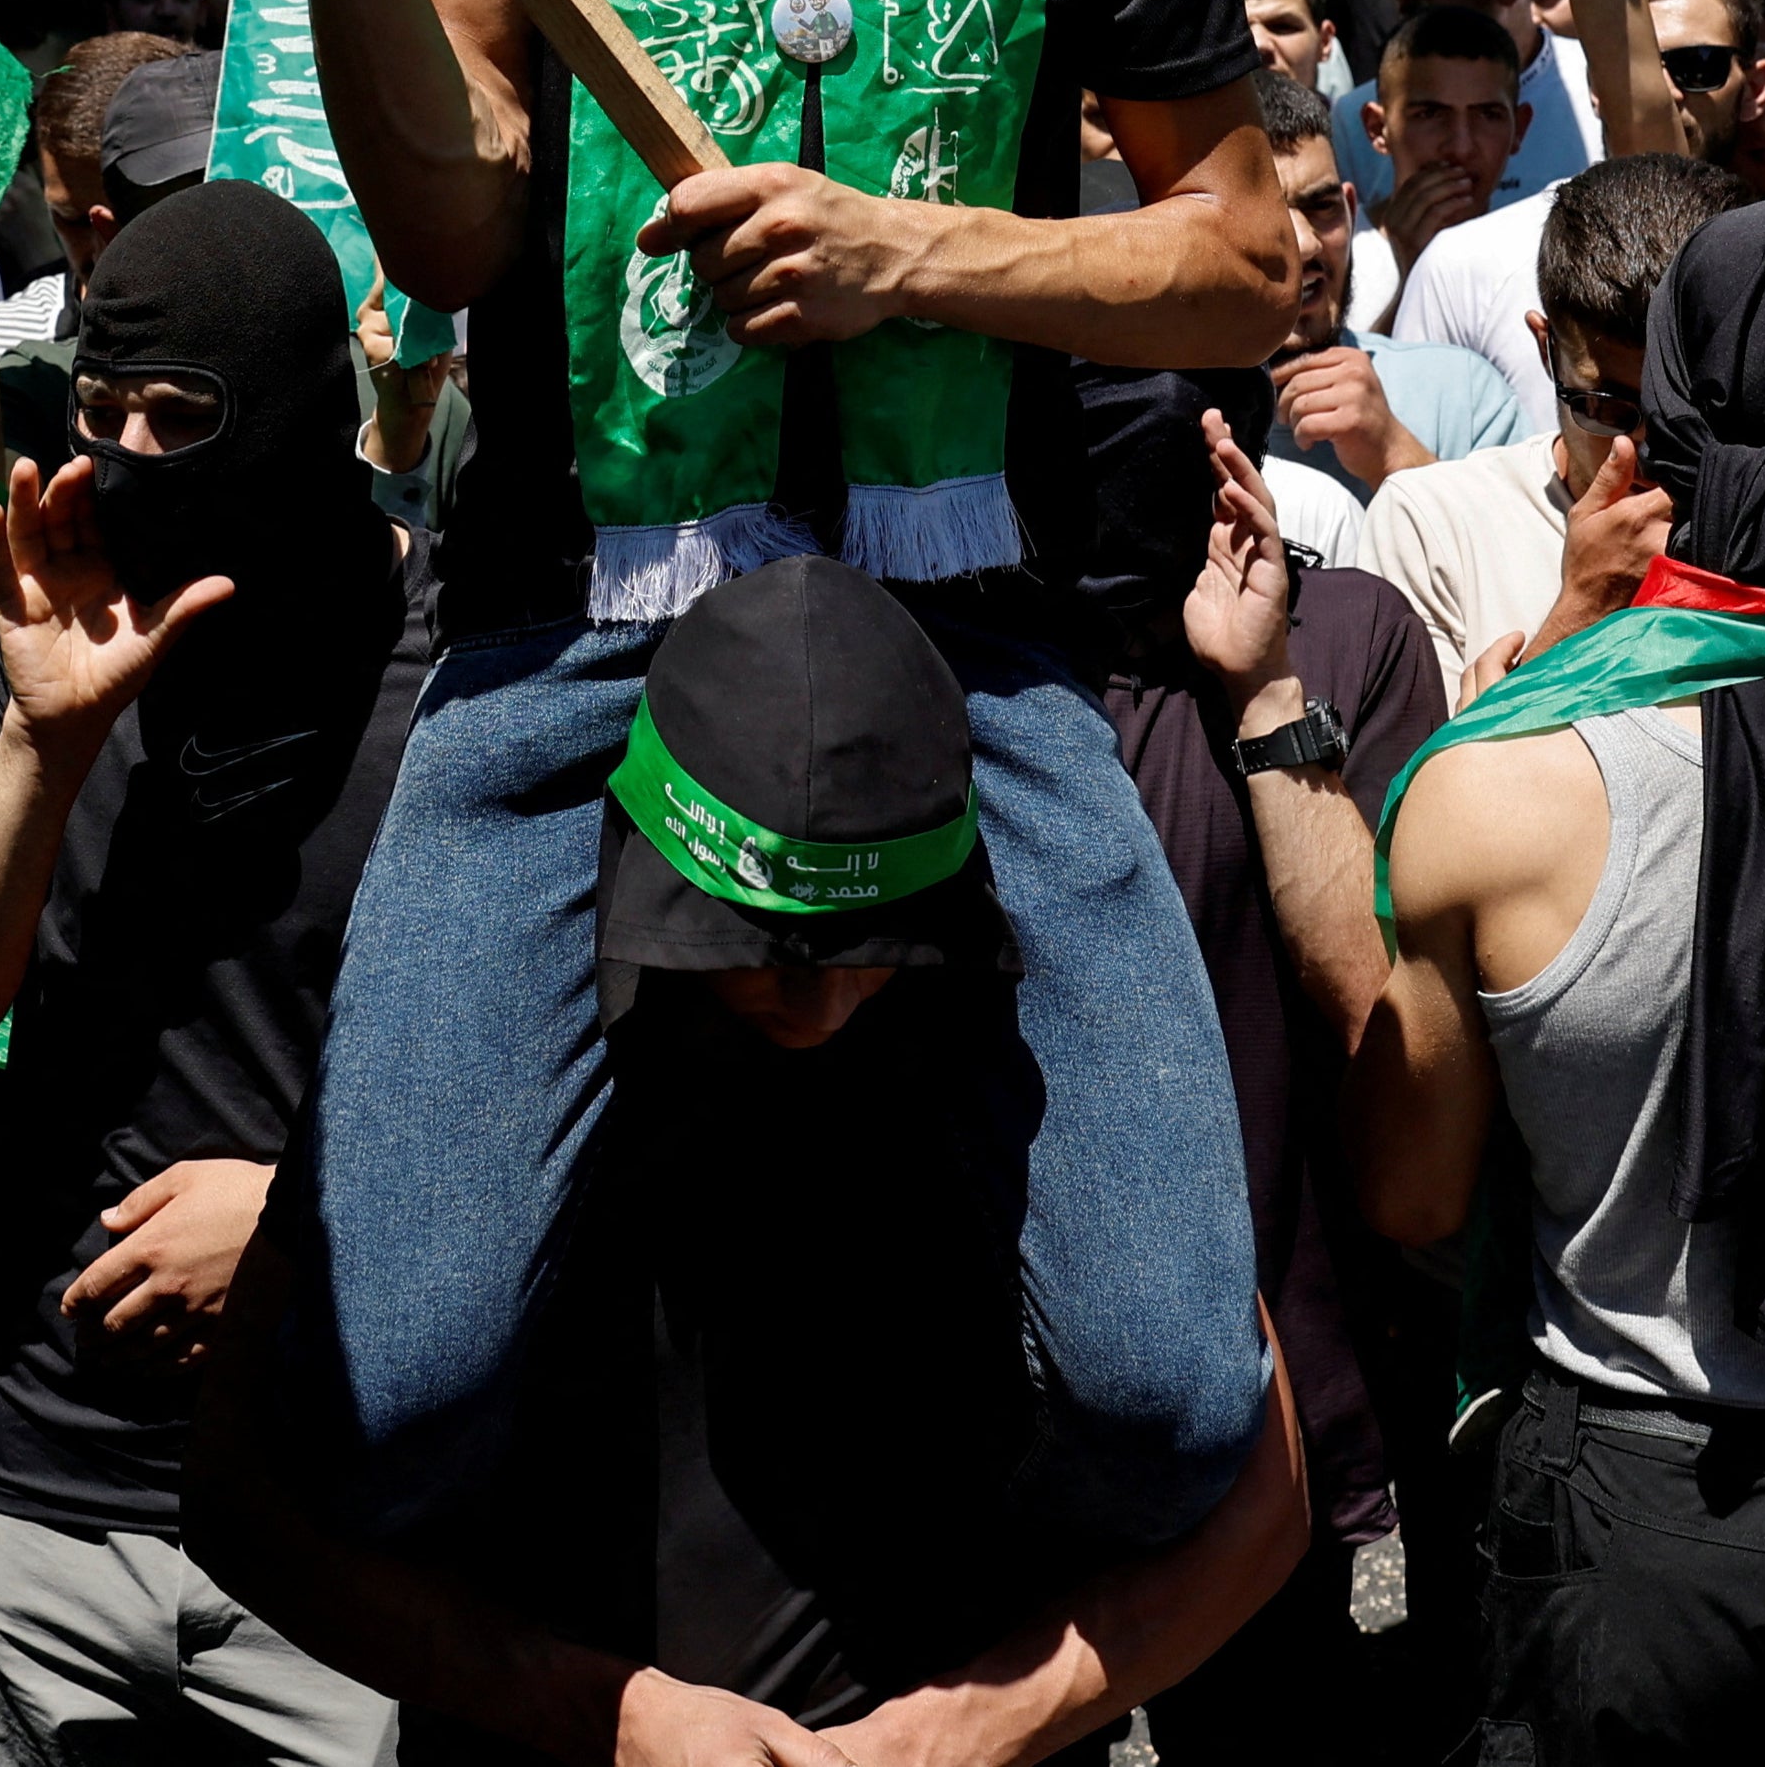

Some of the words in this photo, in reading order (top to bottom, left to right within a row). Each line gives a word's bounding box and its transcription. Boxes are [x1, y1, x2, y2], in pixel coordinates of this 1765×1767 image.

[664, 782, 705, 825] الله
[665, 816, 687, 841] الله
[688, 836, 728, 874] رسول
[786, 854, 861, 878] إله
[867, 851, 880, 871] لا
[825, 884, 879, 899] محمد
